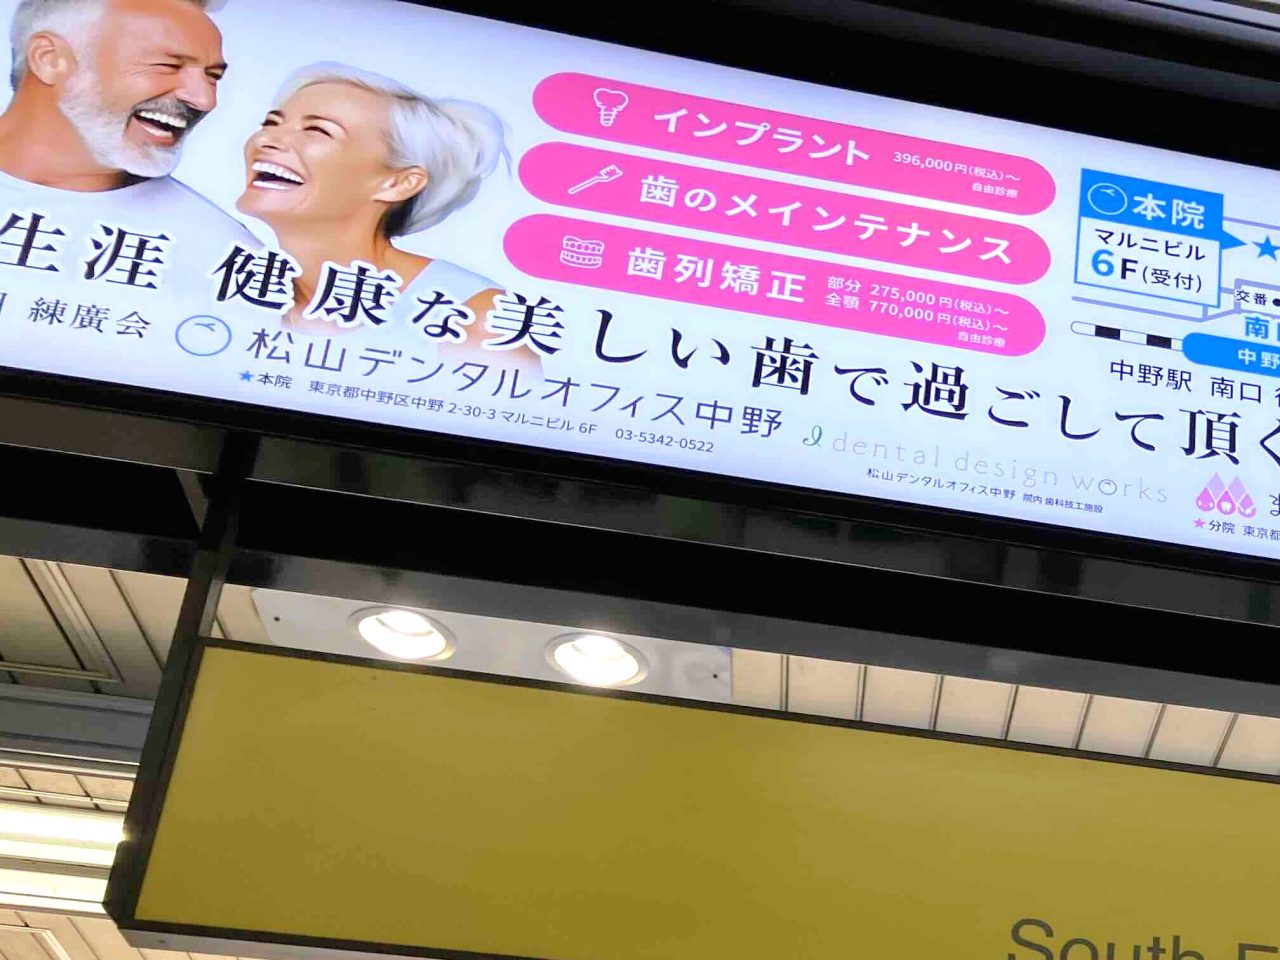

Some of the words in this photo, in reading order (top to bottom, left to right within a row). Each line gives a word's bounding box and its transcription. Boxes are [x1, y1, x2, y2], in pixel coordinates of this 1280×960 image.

[653, 107, 870, 166] インプラント
[972, 182, 1019, 199] 自由診療
[640, 175, 1012, 264] 歯のメインテナンス
[1133, 194, 1205, 229] 本院
[1094, 228, 1207, 262] マルニビル
[626, 247, 807, 304] 歯列矯正
[827, 275, 862, 295] 部分
[1236, 288, 1268, 307] 交番
[958, 331, 1006, 348] 自由診療
[247, 328, 783, 438] 松山デンタルオフィス中野
[1110, 359, 1193, 393] 中野駅
[1211, 377, 1262, 404] 南口
[257, 372, 293, 389] 本院
[615, 427, 715, 453] 03-5342-0522
[832, 432, 940, 468] dental
[954, 450, 1059, 489] design
[1071, 474, 1168, 504] works
[1209, 519, 1236, 535] 分院
